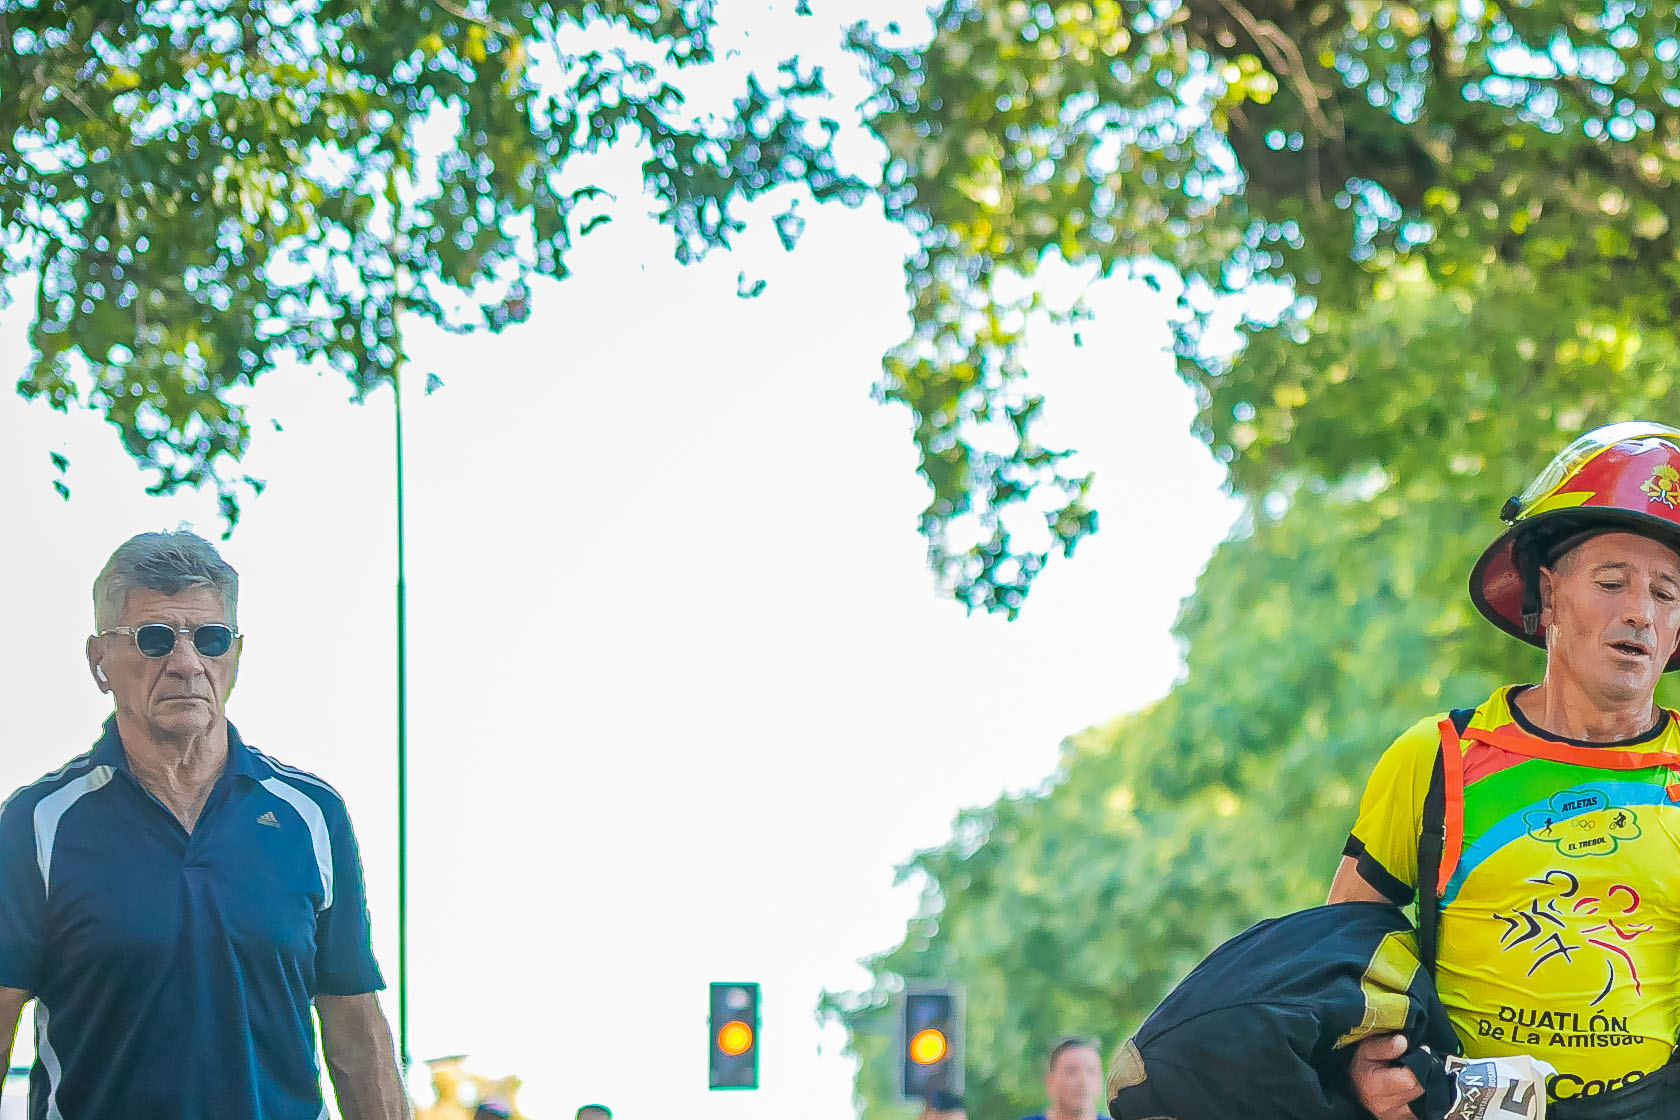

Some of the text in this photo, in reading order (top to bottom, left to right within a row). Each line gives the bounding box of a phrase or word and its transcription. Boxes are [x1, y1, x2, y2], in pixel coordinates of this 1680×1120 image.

[1561, 796, 1598, 813] ATLETAS
[1568, 843, 1577, 851] EL
[1497, 1005, 1630, 1034] DUATLÓN
[1477, 1019, 1505, 1041] De
[1511, 1026, 1541, 1045] La
